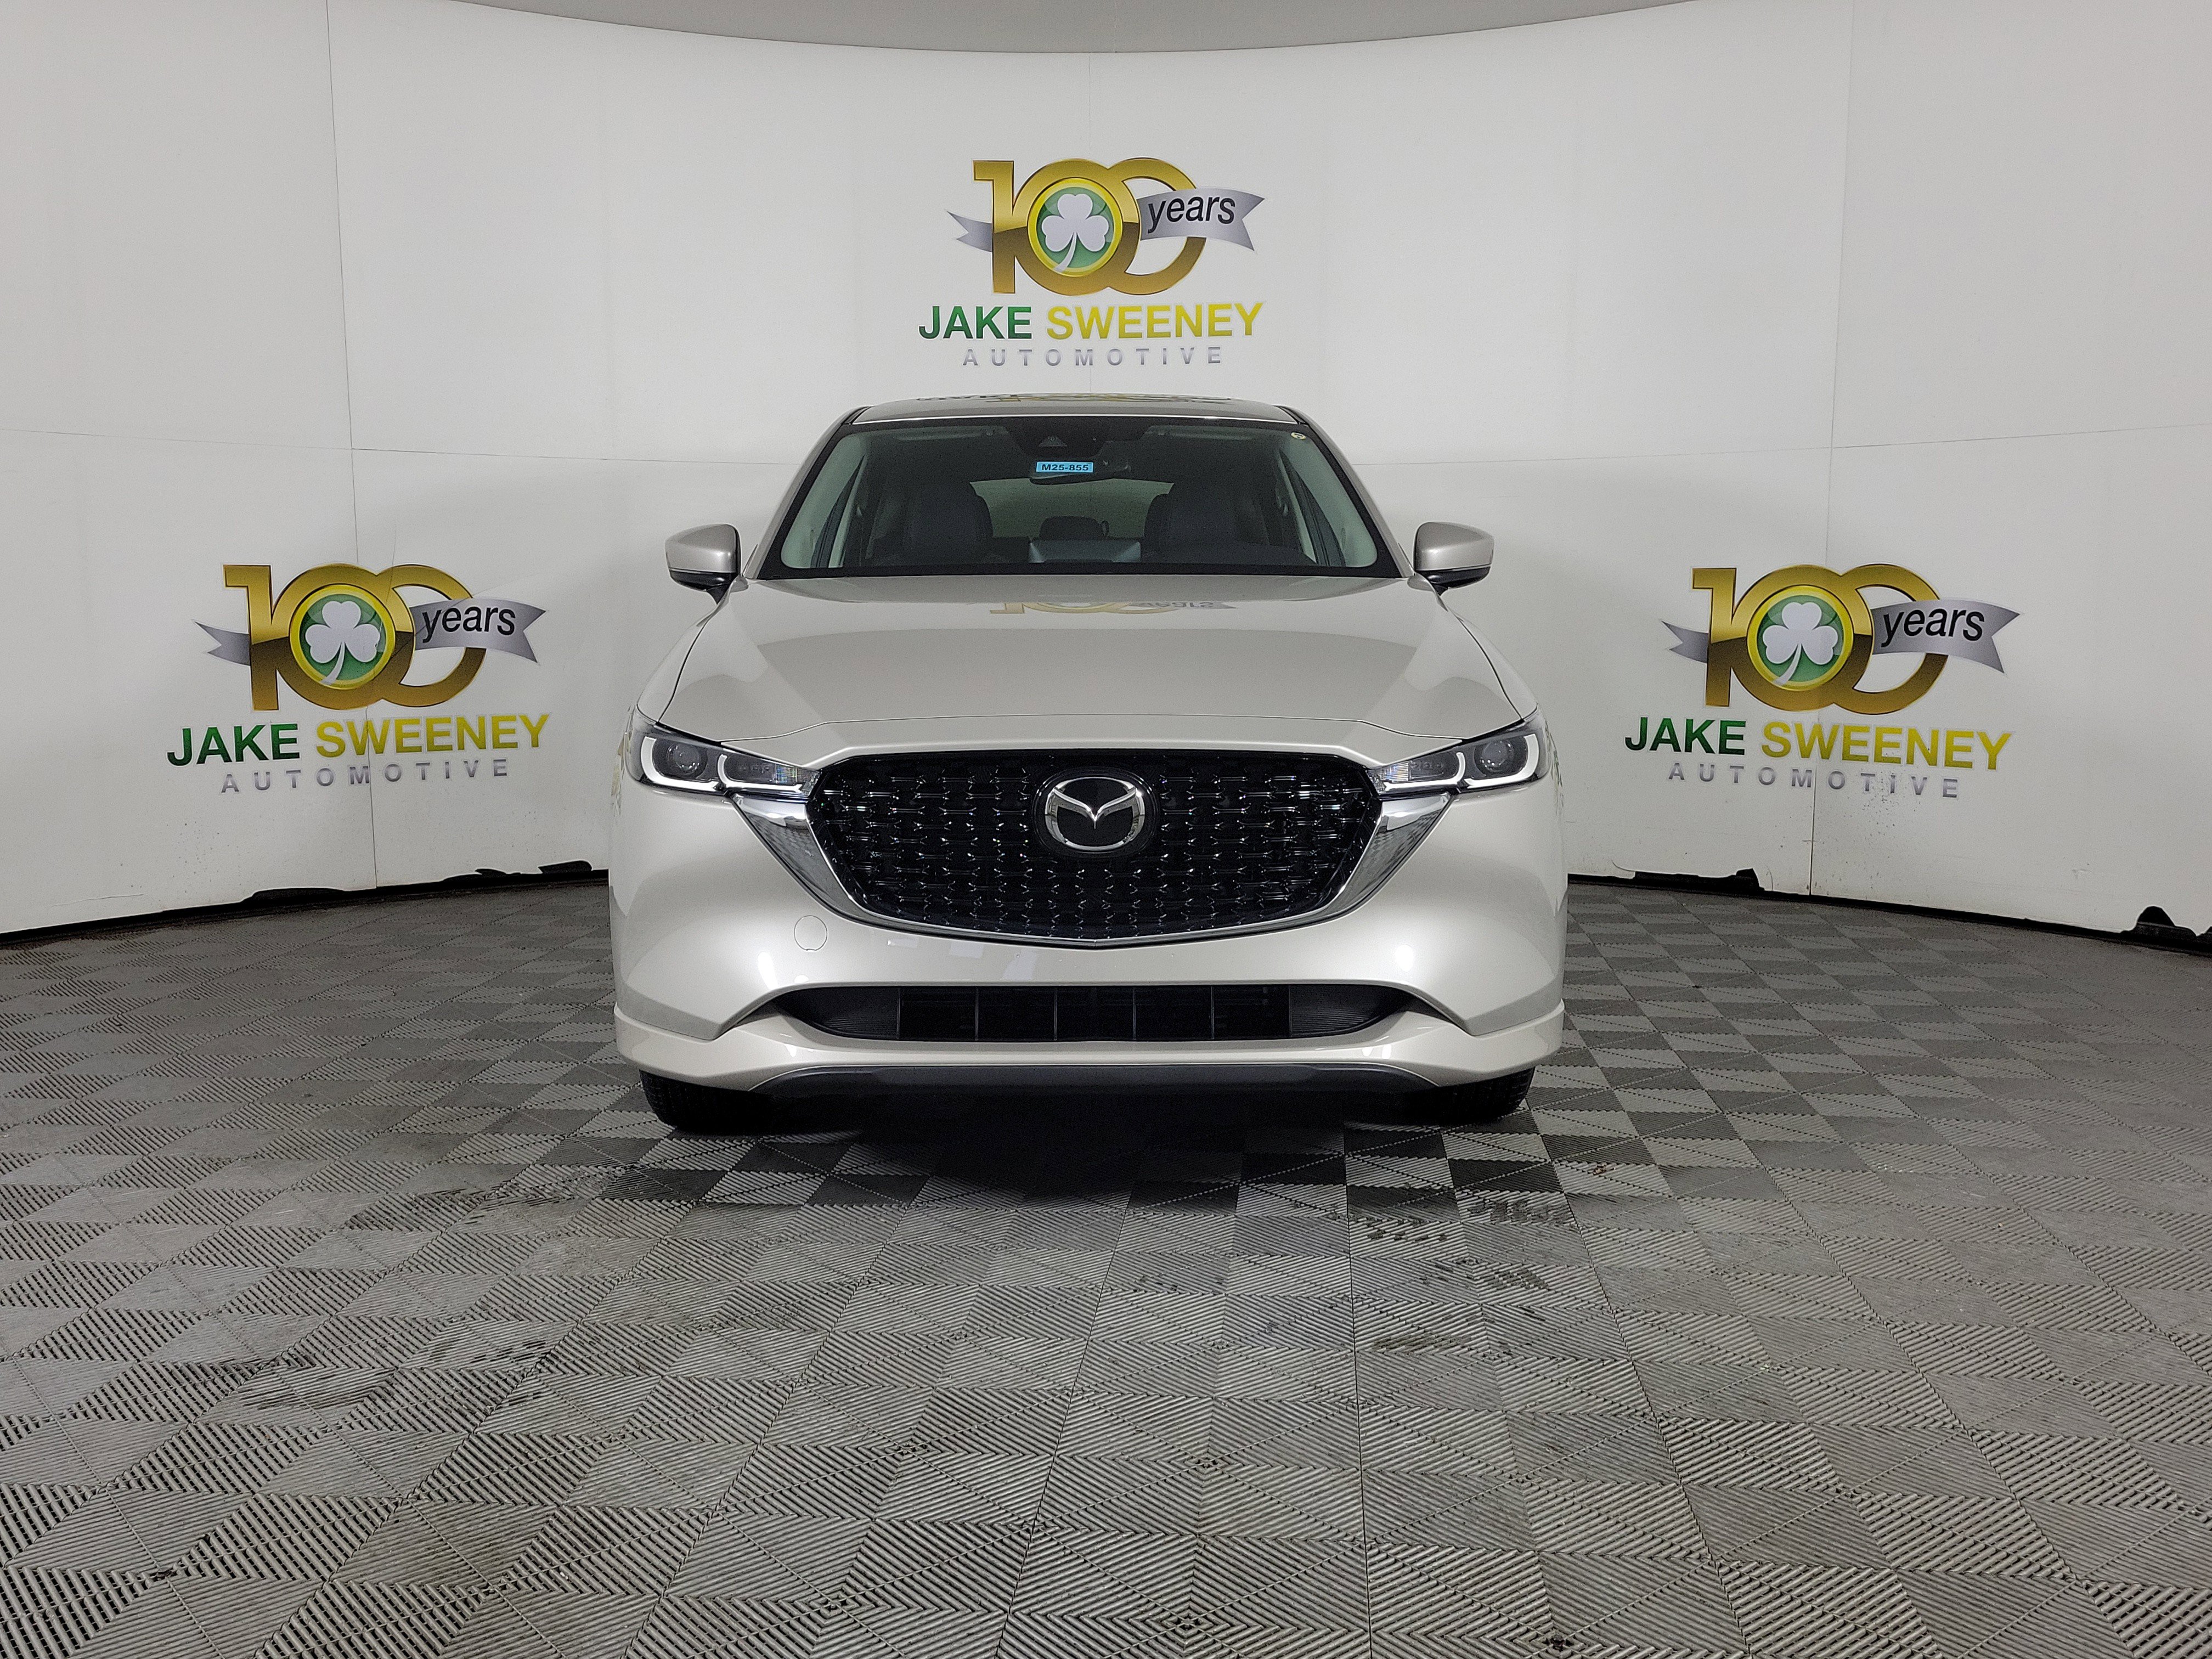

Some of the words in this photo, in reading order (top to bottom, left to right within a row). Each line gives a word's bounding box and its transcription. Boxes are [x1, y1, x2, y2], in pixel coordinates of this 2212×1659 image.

[973, 157, 1206, 295] 100
[1148, 196, 1235, 233] years
[919, 306, 1031, 339] JAKE
[1047, 303, 1262, 340] SWEENEY
[963, 347, 1221, 366] AUTOMOTIVE
[223, 563, 486, 710] 100
[422, 606, 516, 643] years
[1692, 564, 1948, 714] 100
[1881, 607, 1985, 647] years
[167, 723, 300, 766] JAKE
[316, 714, 549, 758] SWEENEY
[1625, 717, 1746, 755] JAKE
[1762, 721, 2011, 770] SWEENEY
[221, 759, 507, 793] AUTOMOTIVE
[1668, 763, 1957, 798] AUTOMOTIVE
